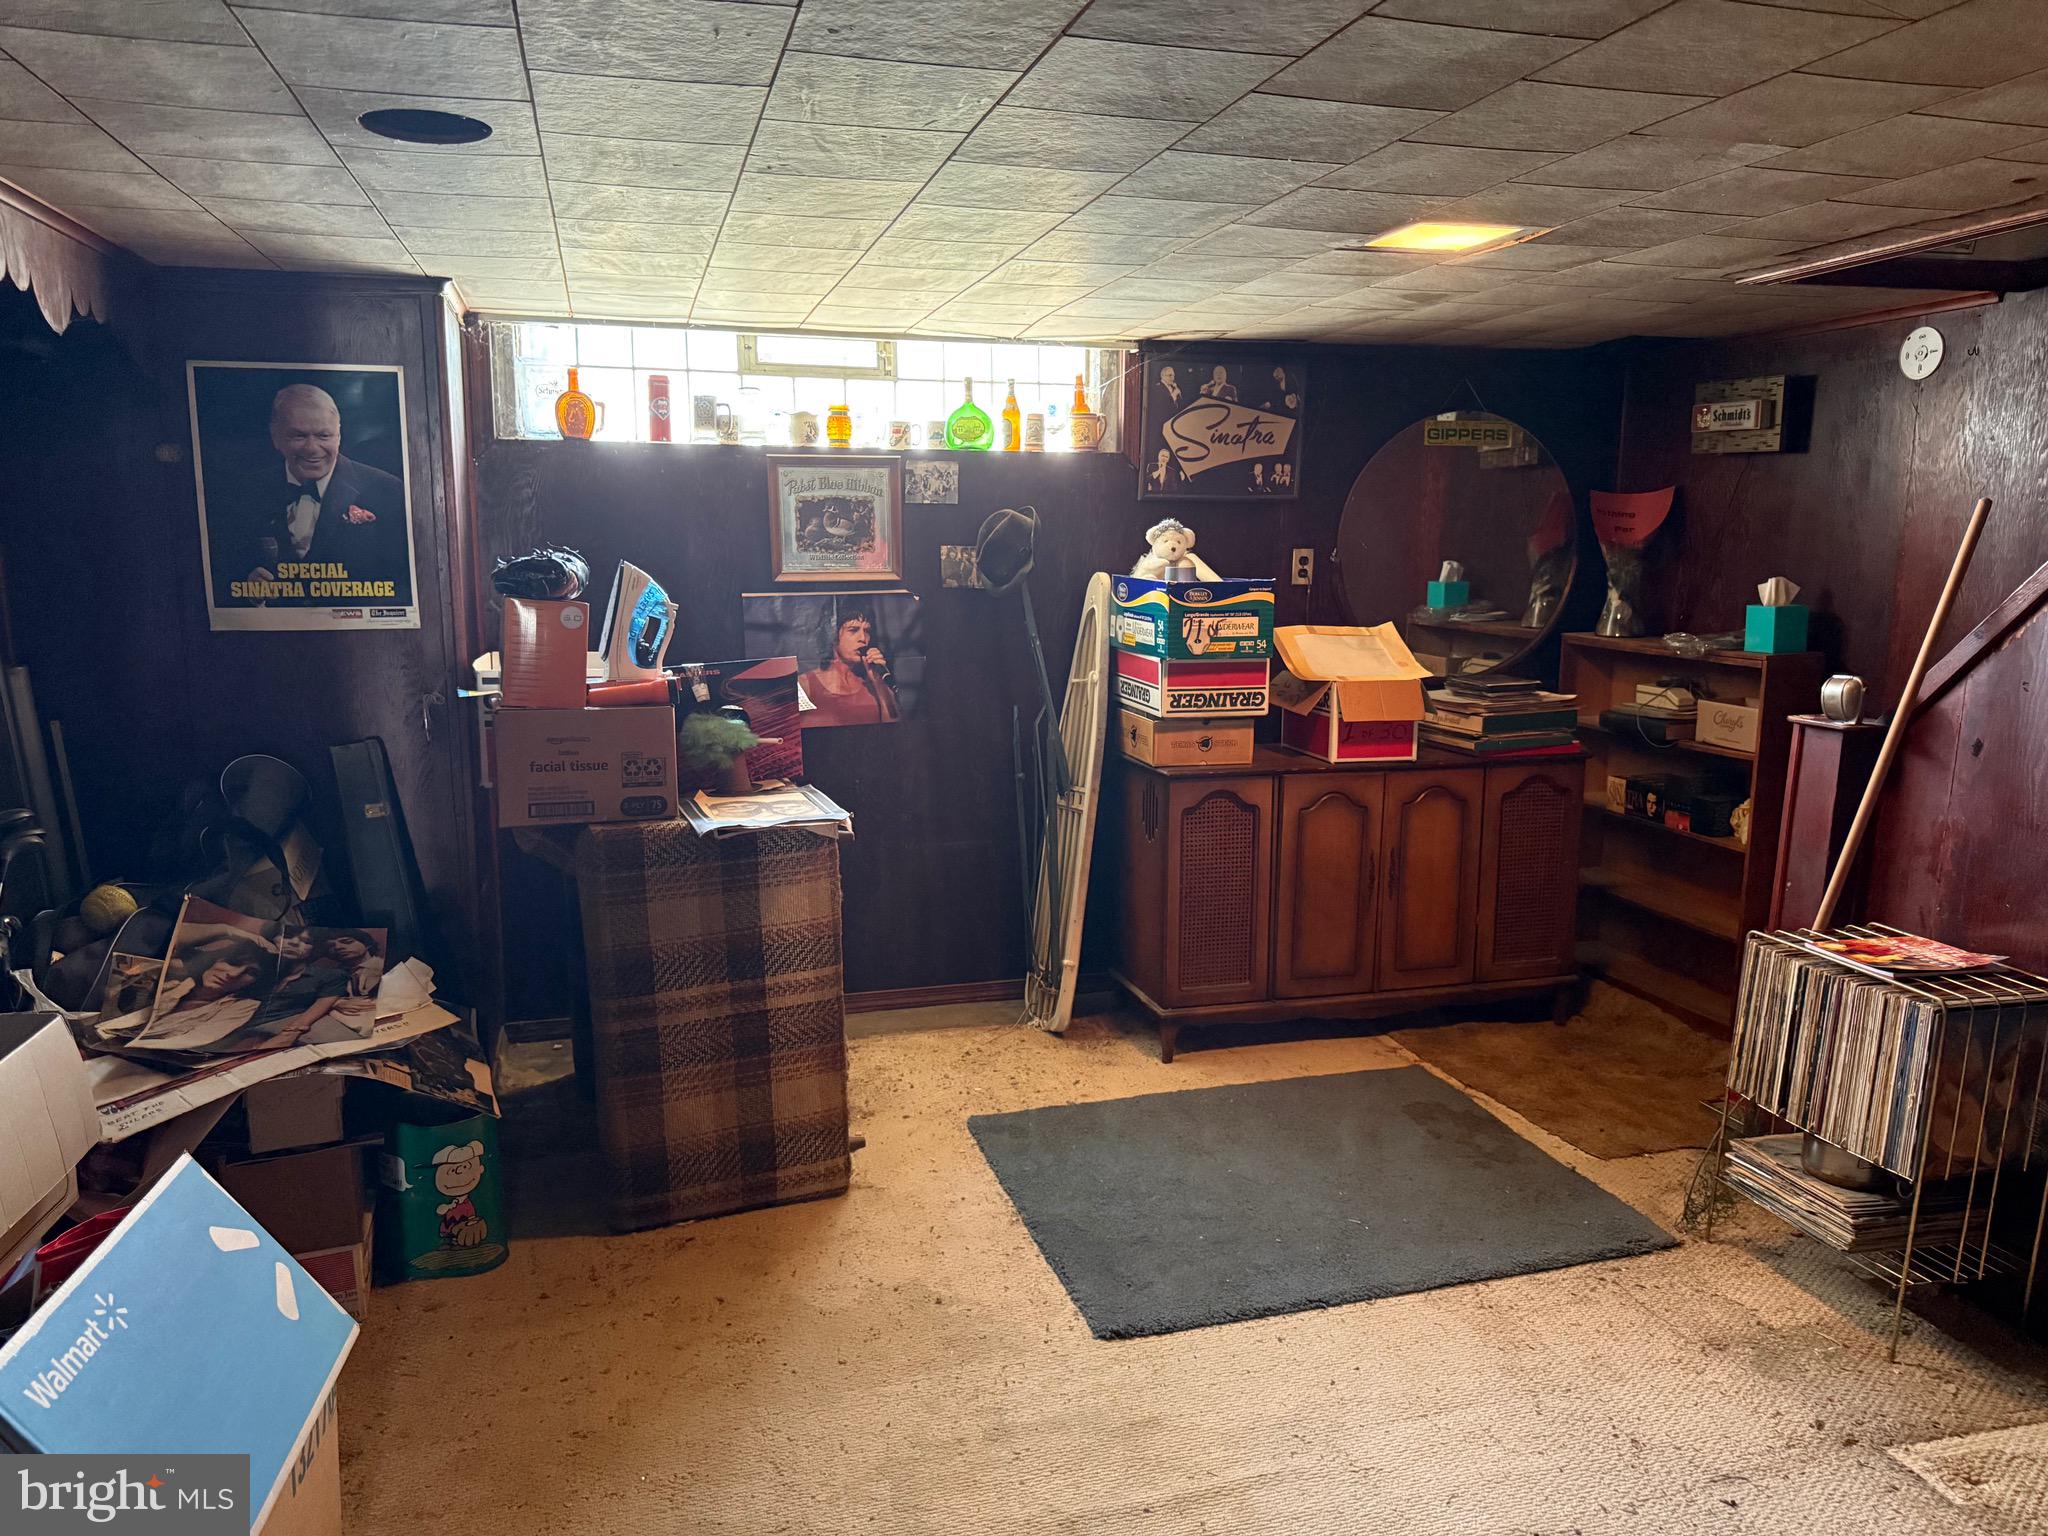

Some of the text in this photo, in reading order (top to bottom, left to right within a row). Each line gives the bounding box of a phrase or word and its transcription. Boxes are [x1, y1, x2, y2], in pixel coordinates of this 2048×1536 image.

[1713, 408, 1751, 422] Schmidt's
[1171, 403, 1280, 462] Sinatra
[1427, 428, 1508, 441] GIPPERS
[784, 477, 884, 497] Pabst Blue Ribbon
[277, 563, 348, 579] SPECIAL
[231, 580, 395, 598] SINATRA COVERAGE
[1256, 639, 1267, 649] 54
[1119, 680, 1151, 704] GRAINGER
[1169, 691, 1266, 709] GRAINGER
[529, 760, 609, 773] facial tissue
[23, 1318, 109, 1409] Walmart
